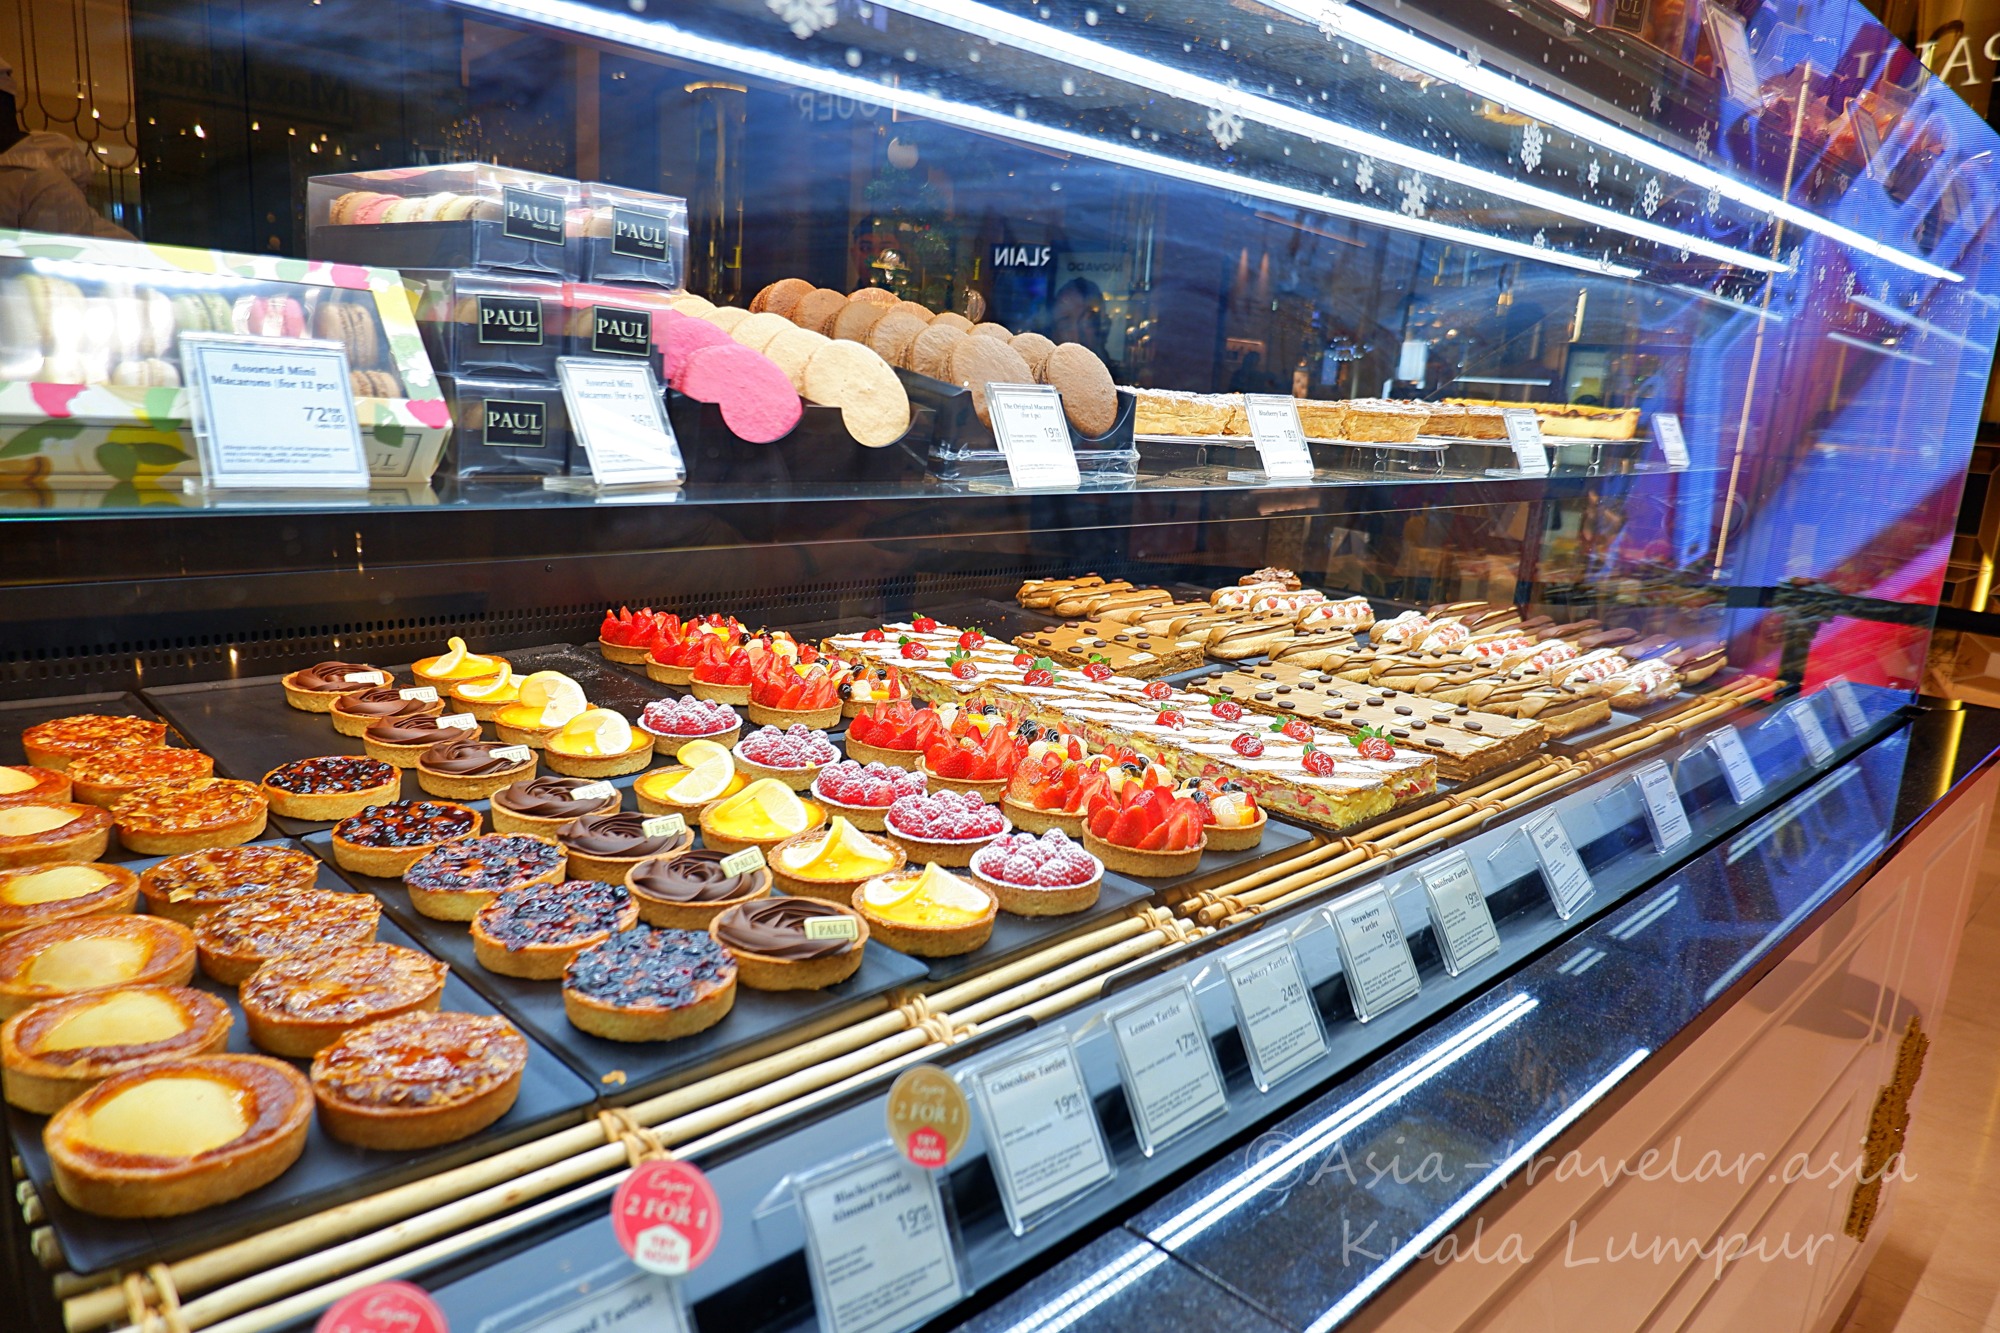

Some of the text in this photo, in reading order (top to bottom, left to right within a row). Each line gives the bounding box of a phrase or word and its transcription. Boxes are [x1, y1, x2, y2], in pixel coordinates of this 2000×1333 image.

[508, 201, 563, 226] PAUL
[616, 220, 666, 244] PAUL
[483, 308, 539, 327] PAUL
[597, 318, 648, 339] PAUL
[231, 363, 316, 376] Assorted Mini
[211, 376, 271, 388] Macarons
[300, 380, 313, 389] 12
[487, 411, 542, 430] PAUL
[368, 453, 400, 467] UL
[655, 821, 679, 834] PAUL
[734, 855, 759, 871] PAUL
[1454, 867, 1469, 880] Tartlet
[1351, 907, 1381, 926] Strawberry
[818, 924, 850, 936] PAUL
[1360, 920, 1379, 934] Tartlet
[1237, 955, 1289, 987] Raspberry Tartlet
[1128, 1003, 1181, 1037] Lemon Tartlet
[991, 1057, 1067, 1096] Chocolate Tartlet
[911, 1079, 947, 1101] Enjoy
[895, 1104, 960, 1125] 2 FOR 1
[916, 1134, 938, 1146] TRY
[914, 1147, 941, 1161] NOW
[648, 1168, 694, 1201] Enjoy
[625, 1194, 709, 1229] 2 FOR 1
[651, 1235, 678, 1251] TRY
[644, 1248, 682, 1266] NOW
